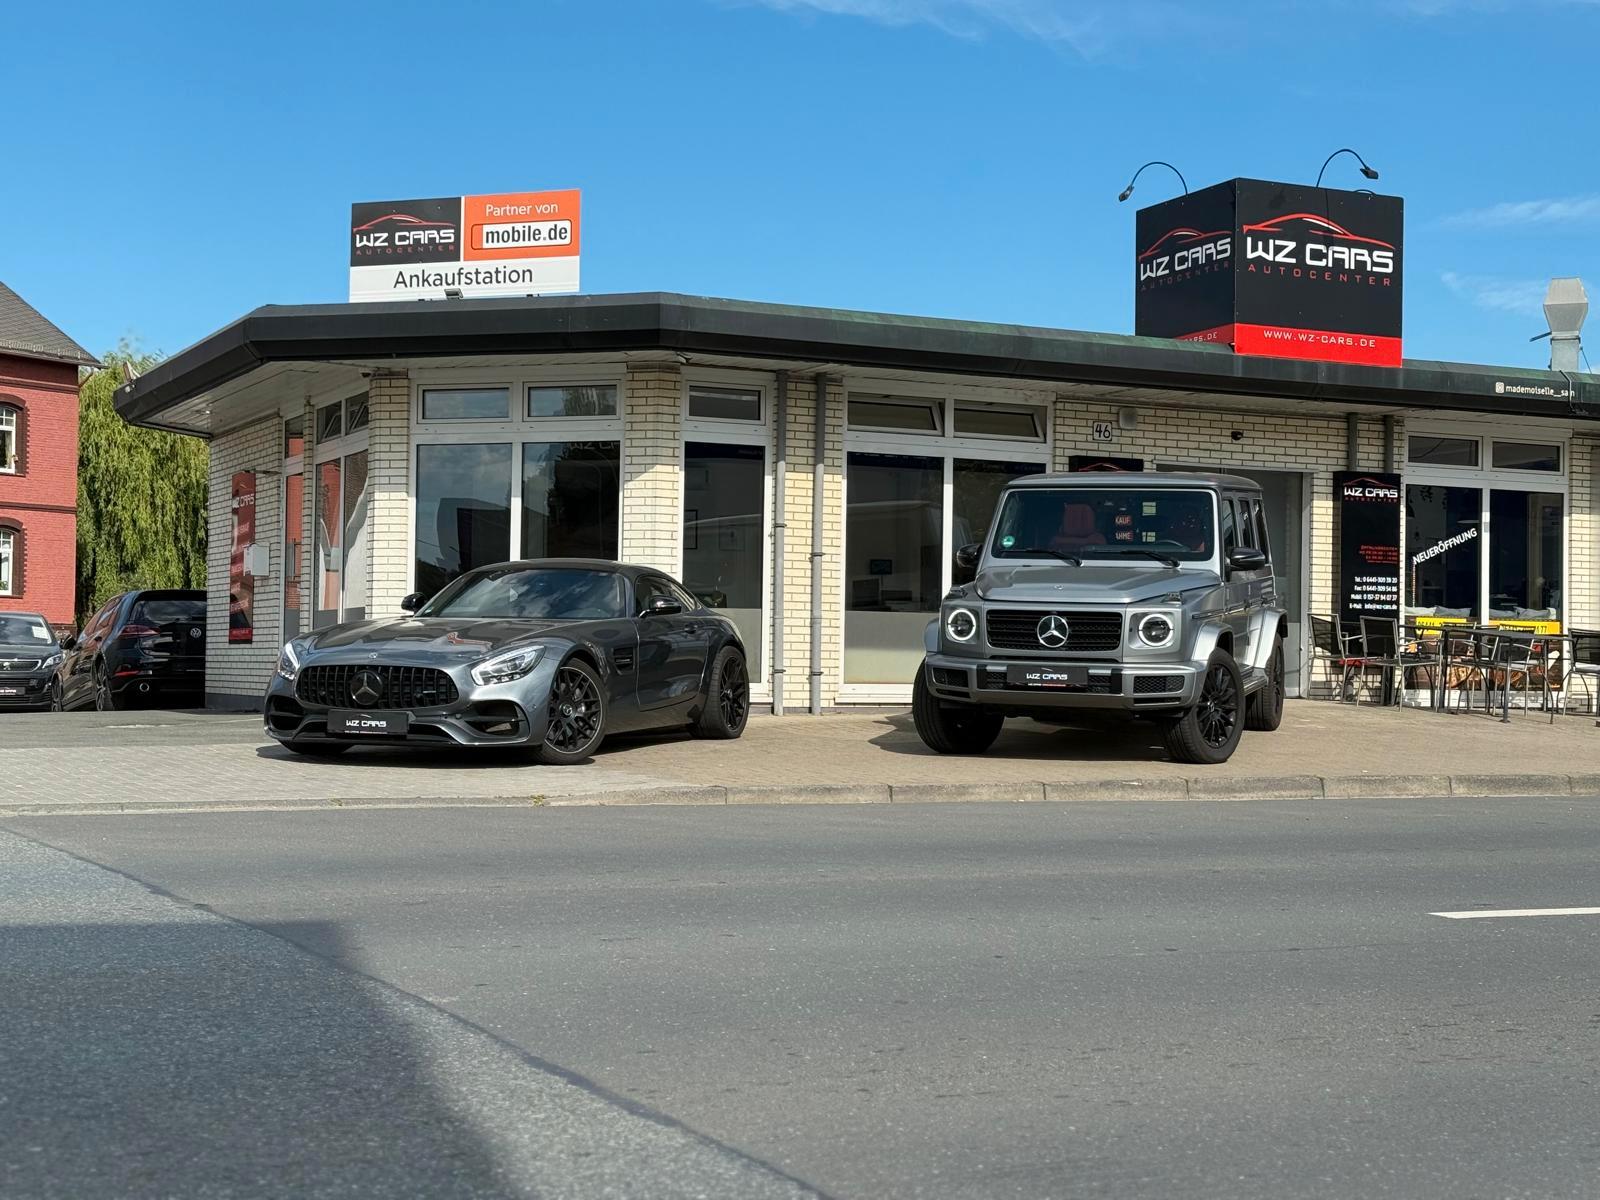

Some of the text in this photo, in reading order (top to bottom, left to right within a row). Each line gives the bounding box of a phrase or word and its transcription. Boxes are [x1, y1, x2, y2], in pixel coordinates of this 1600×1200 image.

[485, 203, 559, 217] Partner von
[355, 229, 455, 248] WZ CARS
[485, 225, 568, 244] mobile.de
[355, 245, 455, 256] AUTOCENTER
[1140, 237, 1231, 281] WZ CARS
[1246, 236, 1394, 274] WZ CARS
[393, 267, 533, 288] Ankaufstation
[1247, 264, 1392, 287] AUTOCENTER
[1263, 329, 1376, 348] WWW.WZ-CARS.DE
[1094, 423, 1111, 439] 46
[1344, 486, 1398, 498] WZ CARS
[1412, 527, 1478, 565] NEUERÖFFNUNG
[345, 719, 387, 728] WZ CARS
